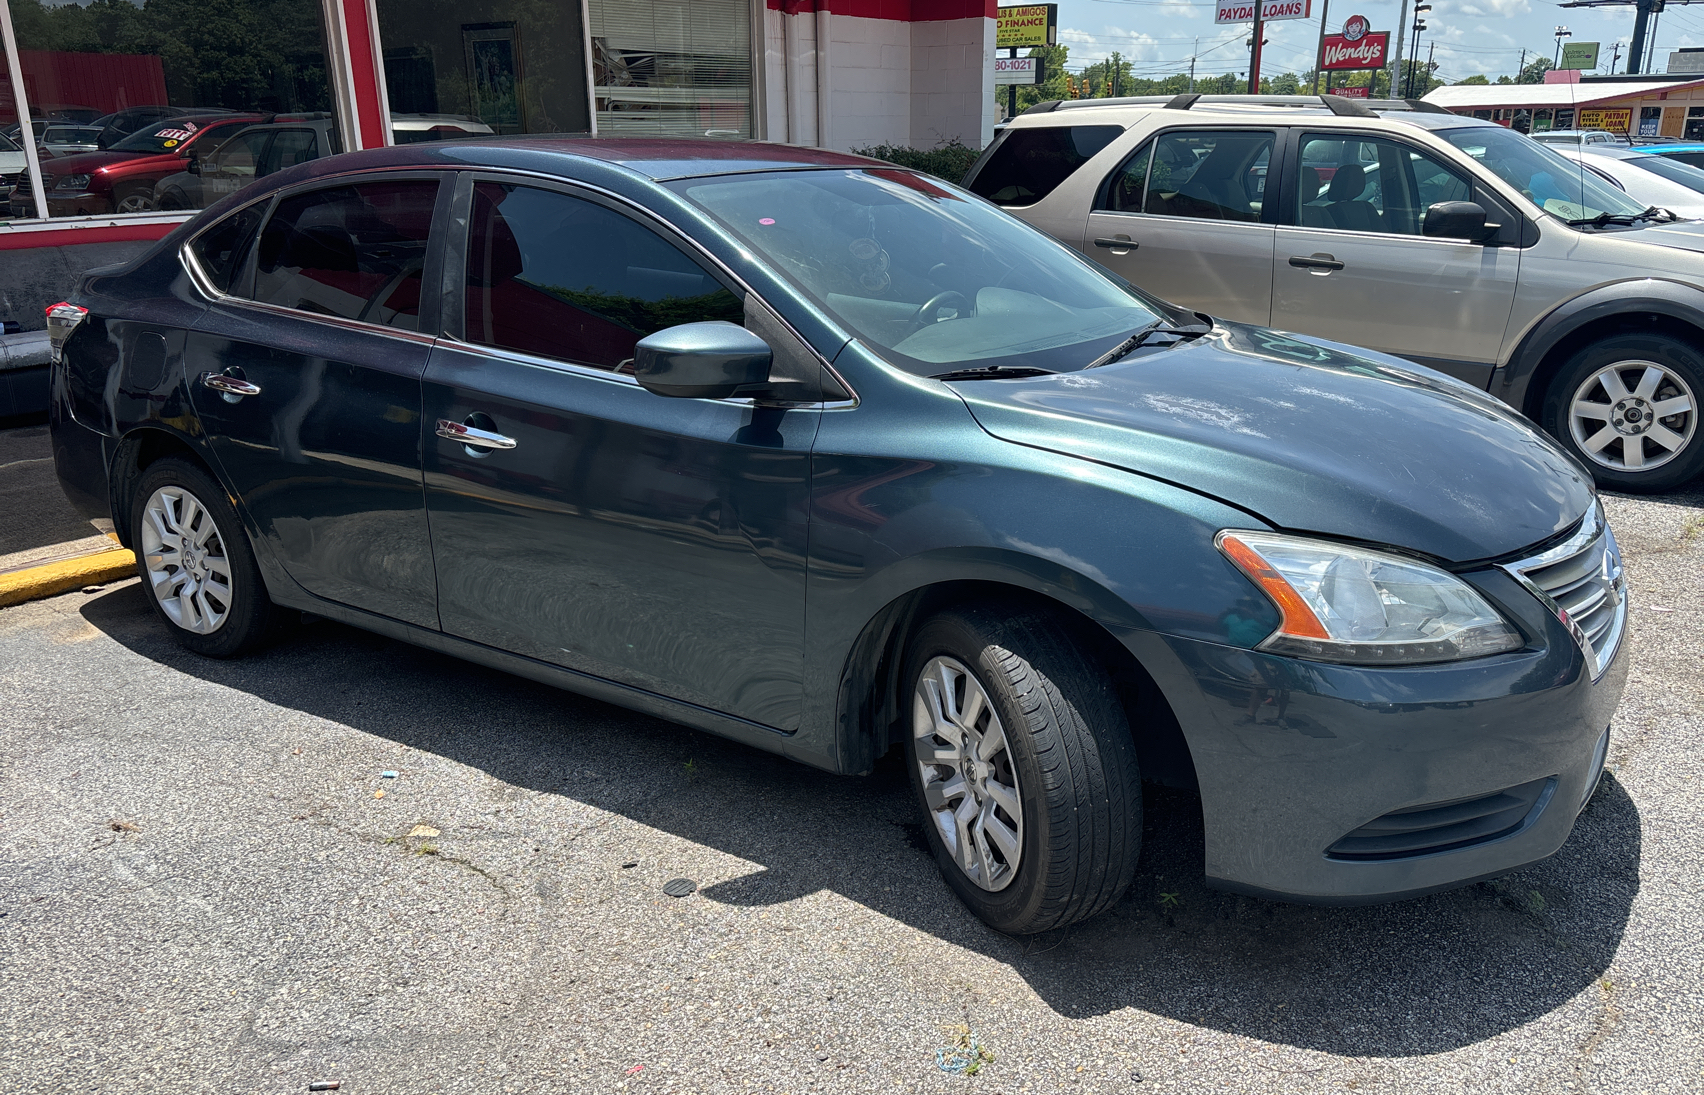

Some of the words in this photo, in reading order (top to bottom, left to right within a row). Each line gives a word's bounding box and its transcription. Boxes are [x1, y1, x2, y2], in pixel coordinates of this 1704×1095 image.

[1008, 8, 1013, 18] &
[1016, 7, 1046, 17] AMIGOS
[1218, 6, 1256, 20] PAYDA
[1262, 2, 1302, 17] LOANS
[1005, 18, 1044, 28] FINANCE
[1324, 39, 1382, 65] Wendy's
[995, 59, 1031, 71] 80-1021
